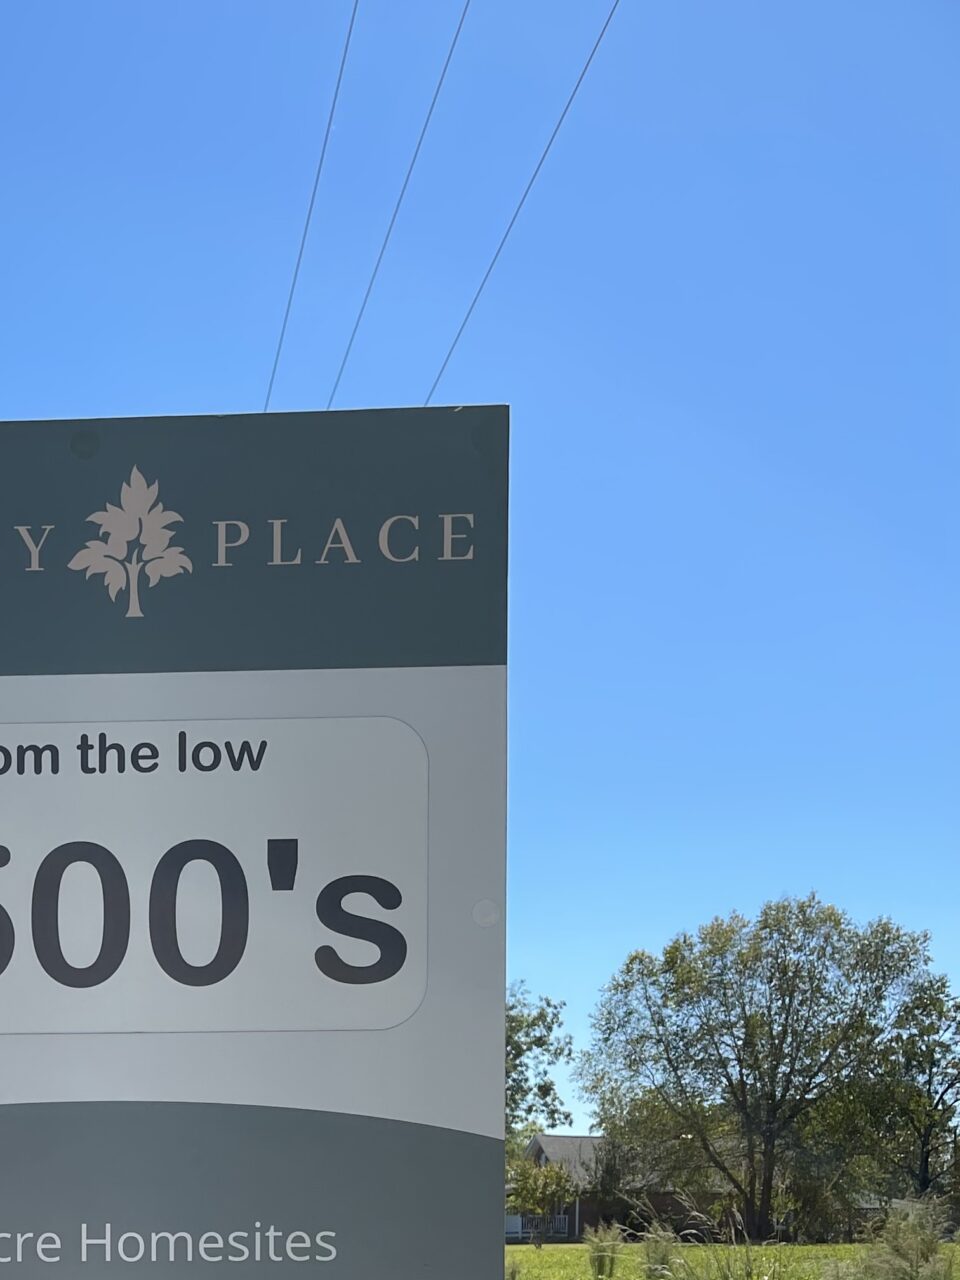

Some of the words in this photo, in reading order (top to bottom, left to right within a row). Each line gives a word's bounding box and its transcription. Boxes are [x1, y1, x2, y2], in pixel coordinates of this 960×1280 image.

[211, 513, 475, 567] PLACE
[76, 732, 160, 774] the
[177, 730, 268, 773] low
[79, 1221, 338, 1263] Homesites
